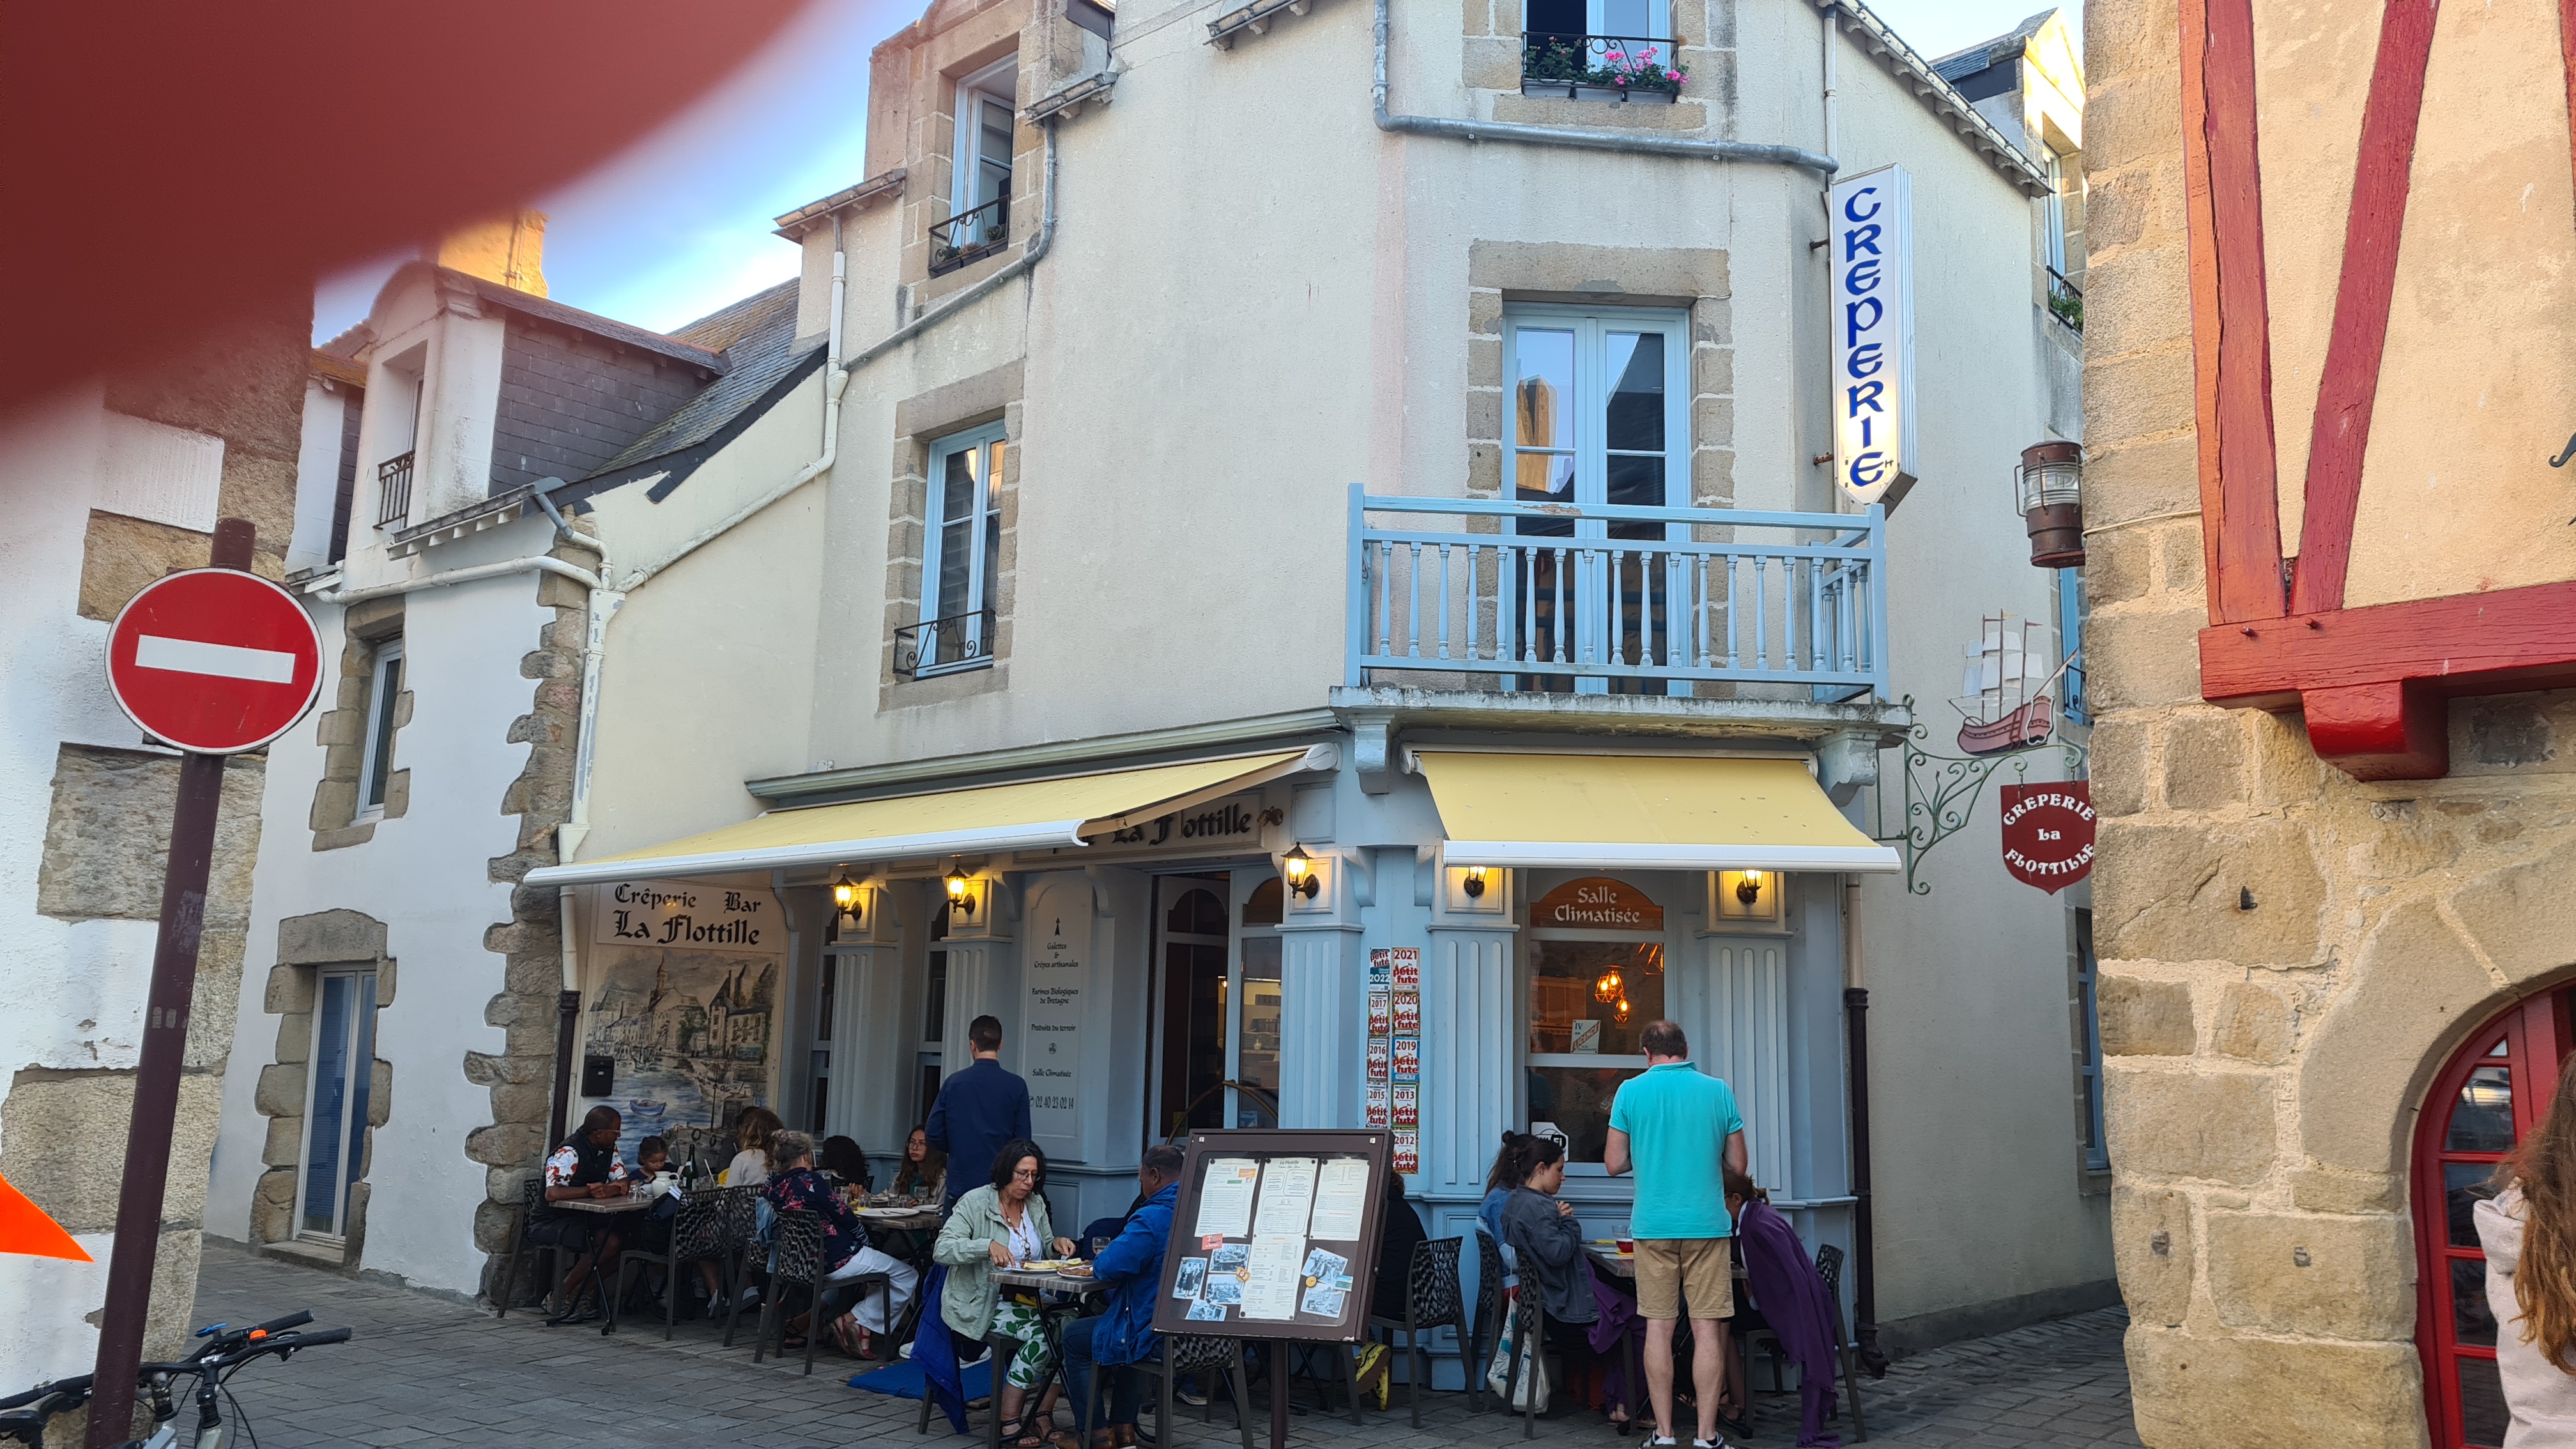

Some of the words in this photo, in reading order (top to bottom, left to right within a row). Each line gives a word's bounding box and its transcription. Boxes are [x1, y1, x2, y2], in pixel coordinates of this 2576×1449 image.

[1844, 187, 1885, 487] CREPERIE
[2003, 793, 2096, 825] CREPERIE
[2037, 828, 2061, 841] La
[2004, 843, 2094, 875] FLOTTILLE
[615, 883, 697, 910] Crêperie
[723, 891, 762, 914] Bar
[1577, 885, 1617, 904] Salle
[1554, 903, 1640, 923] Climatisée
[613, 909, 650, 939] La
[656, 914, 760, 945] Flottille
[1370, 951, 1388, 962] petit
[1394, 950, 1417, 960] 2021
[1393, 966, 1418, 977] petit
[1369, 974, 1390, 983] 2022
[1051, 987, 1078, 996] Biologiques
[1046, 997, 1070, 1006] Bretagne
[1394, 995, 1418, 1005] 2020
[1368, 1015, 1390, 1025] petit
[1393, 1012, 1419, 1022] petit
[1369, 1046, 1386, 1054] 2016
[1396, 1041, 1416, 1050] 2019
[1368, 1060, 1388, 1070] petit
[1393, 1057, 1418, 1066] petit
[1045, 1069, 1071, 1077] Climatisée
[1369, 1091, 1385, 1099] 2015
[1035, 1096, 1043, 1107] 02
[1044, 1096, 1051, 1108] 40
[1052, 1096, 1059, 1108] 23
[1060, 1097, 1067, 1109] 02
[1367, 1107, 1387, 1117] petit
[1392, 1108, 1417, 1119] petit
[1395, 1136, 1414, 1144] 2012
[1393, 1153, 1418, 1162] petit
